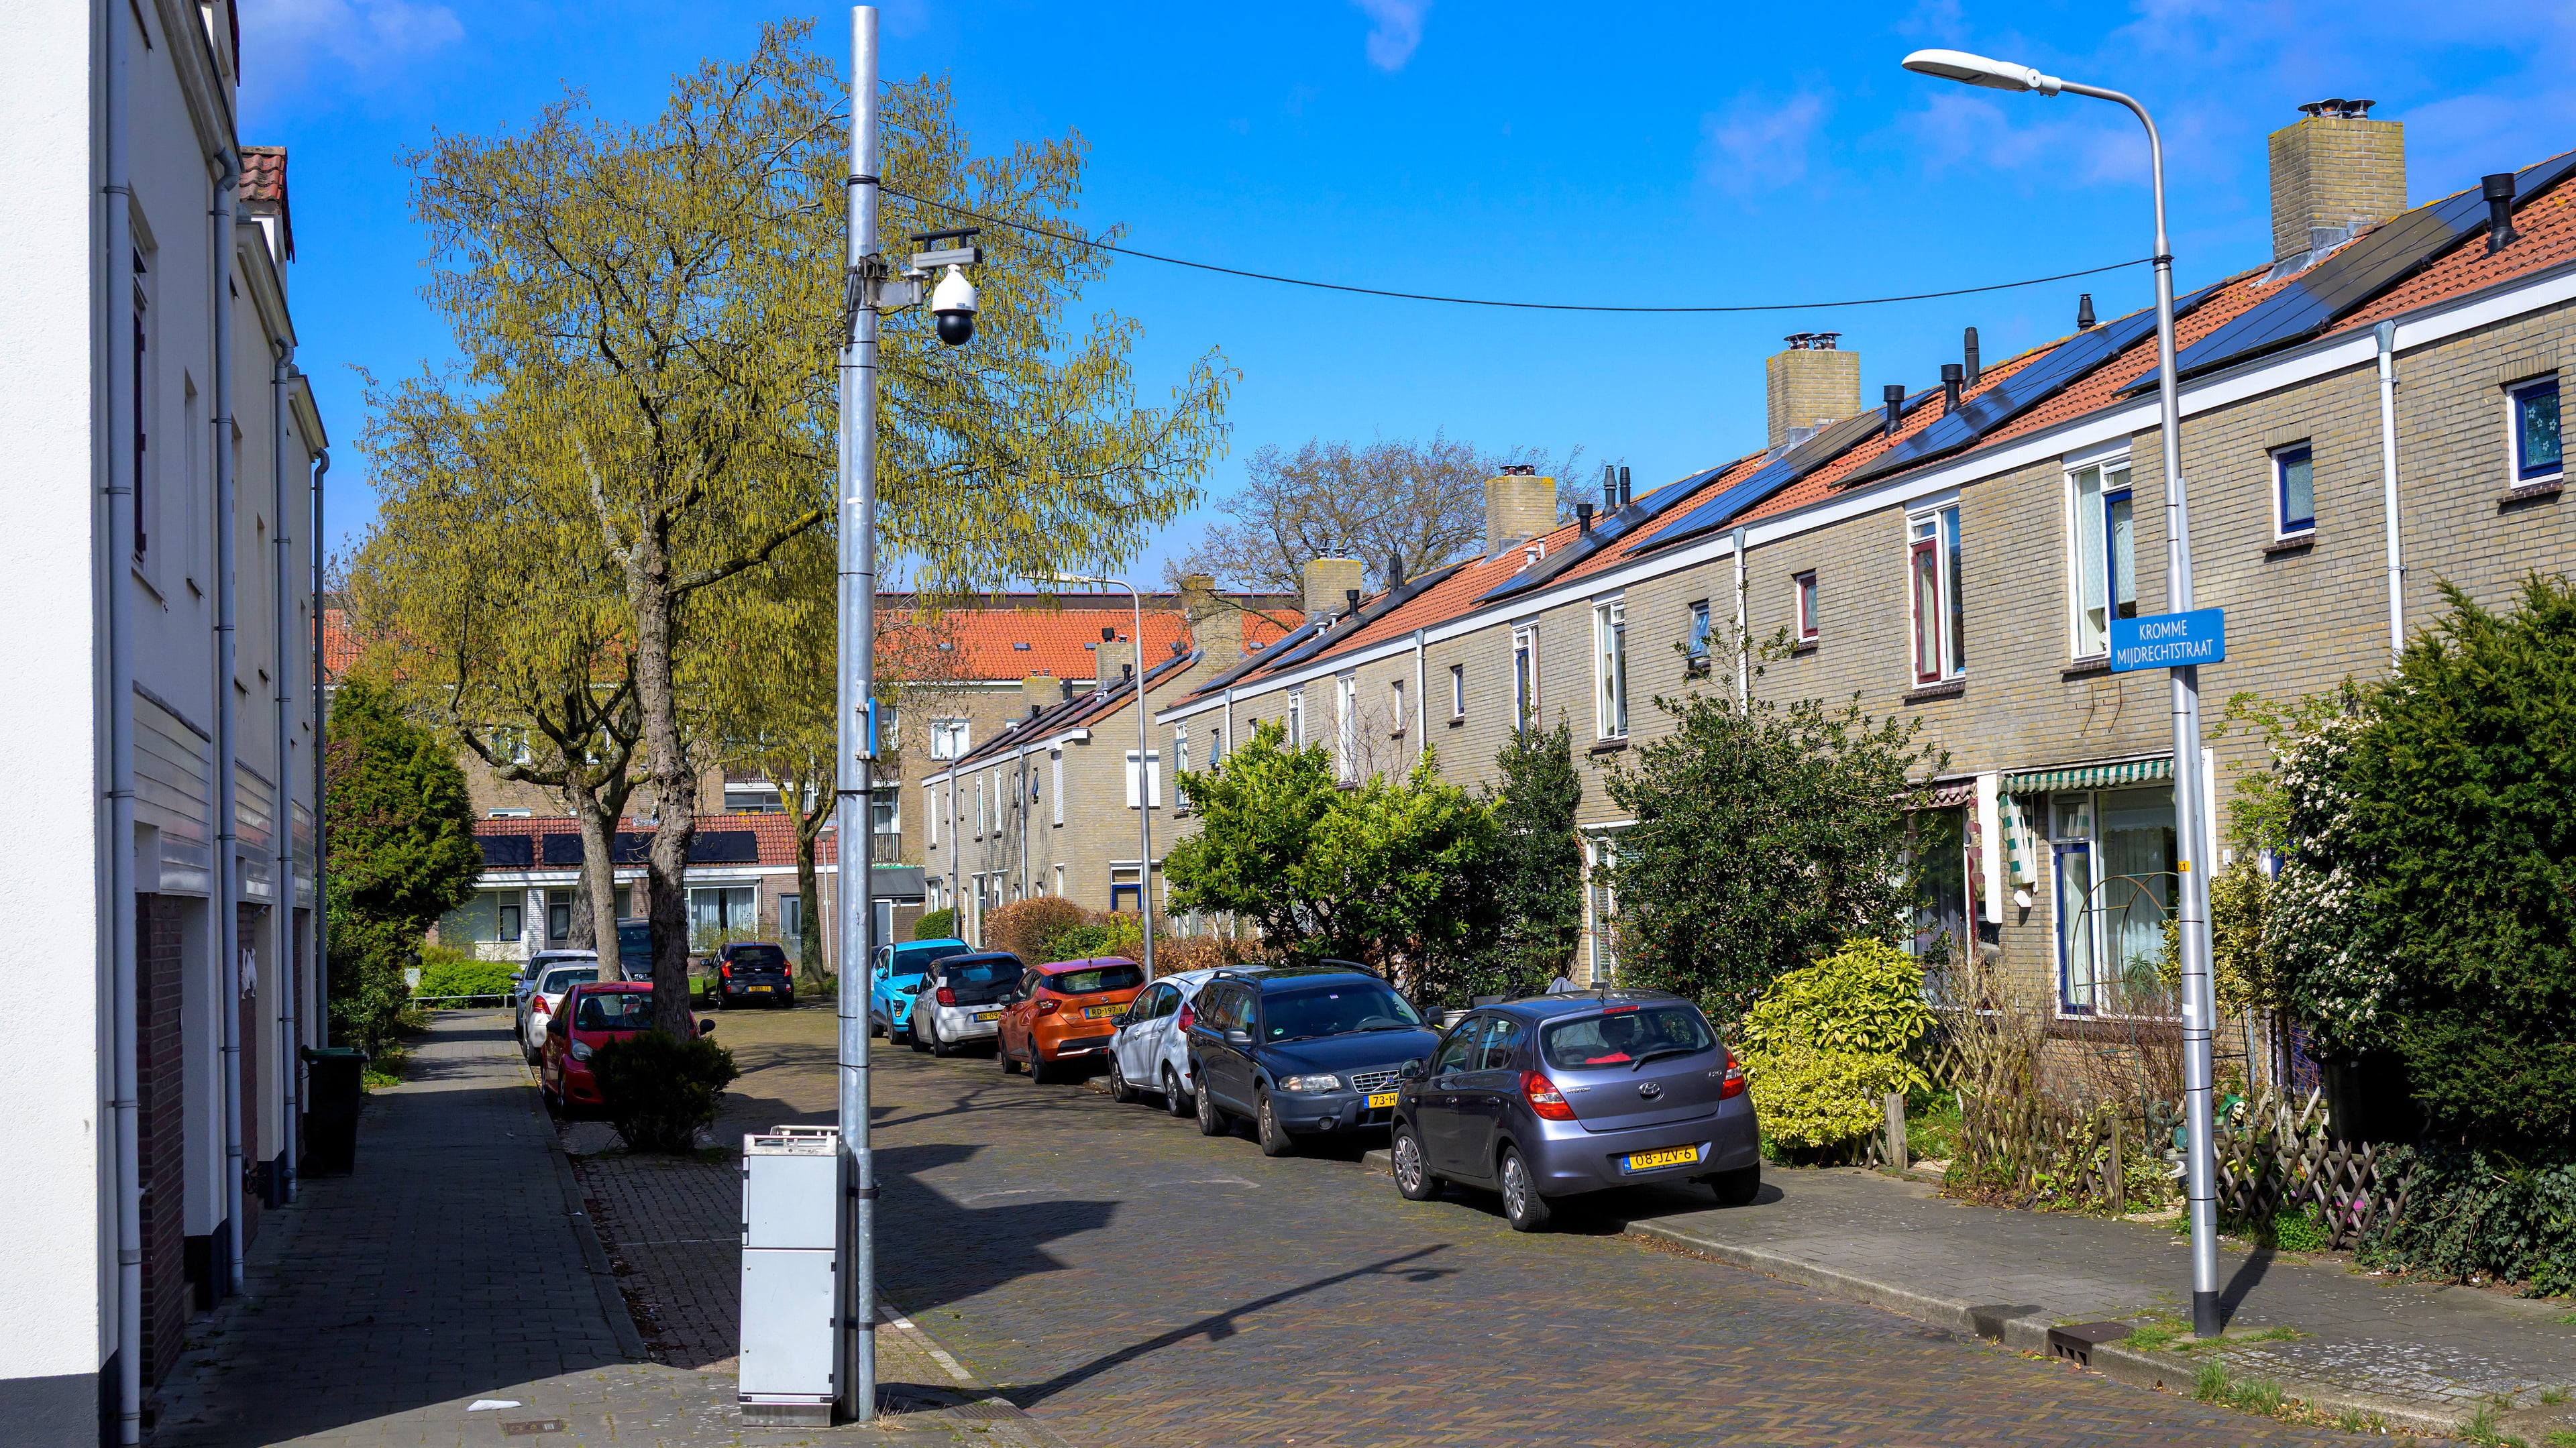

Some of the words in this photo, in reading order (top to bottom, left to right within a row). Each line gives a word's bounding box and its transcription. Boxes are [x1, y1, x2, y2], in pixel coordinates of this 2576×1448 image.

[2139, 620, 2188, 641] KROMME
[2117, 639, 2213, 668] MIJDRECHTSTRAAT
[978, 1012, 1000, 1020] NN-09
[1091, 1006, 1123, 1015] RD-197-V
[1635, 1148, 1691, 1166] 08-JZV-6
